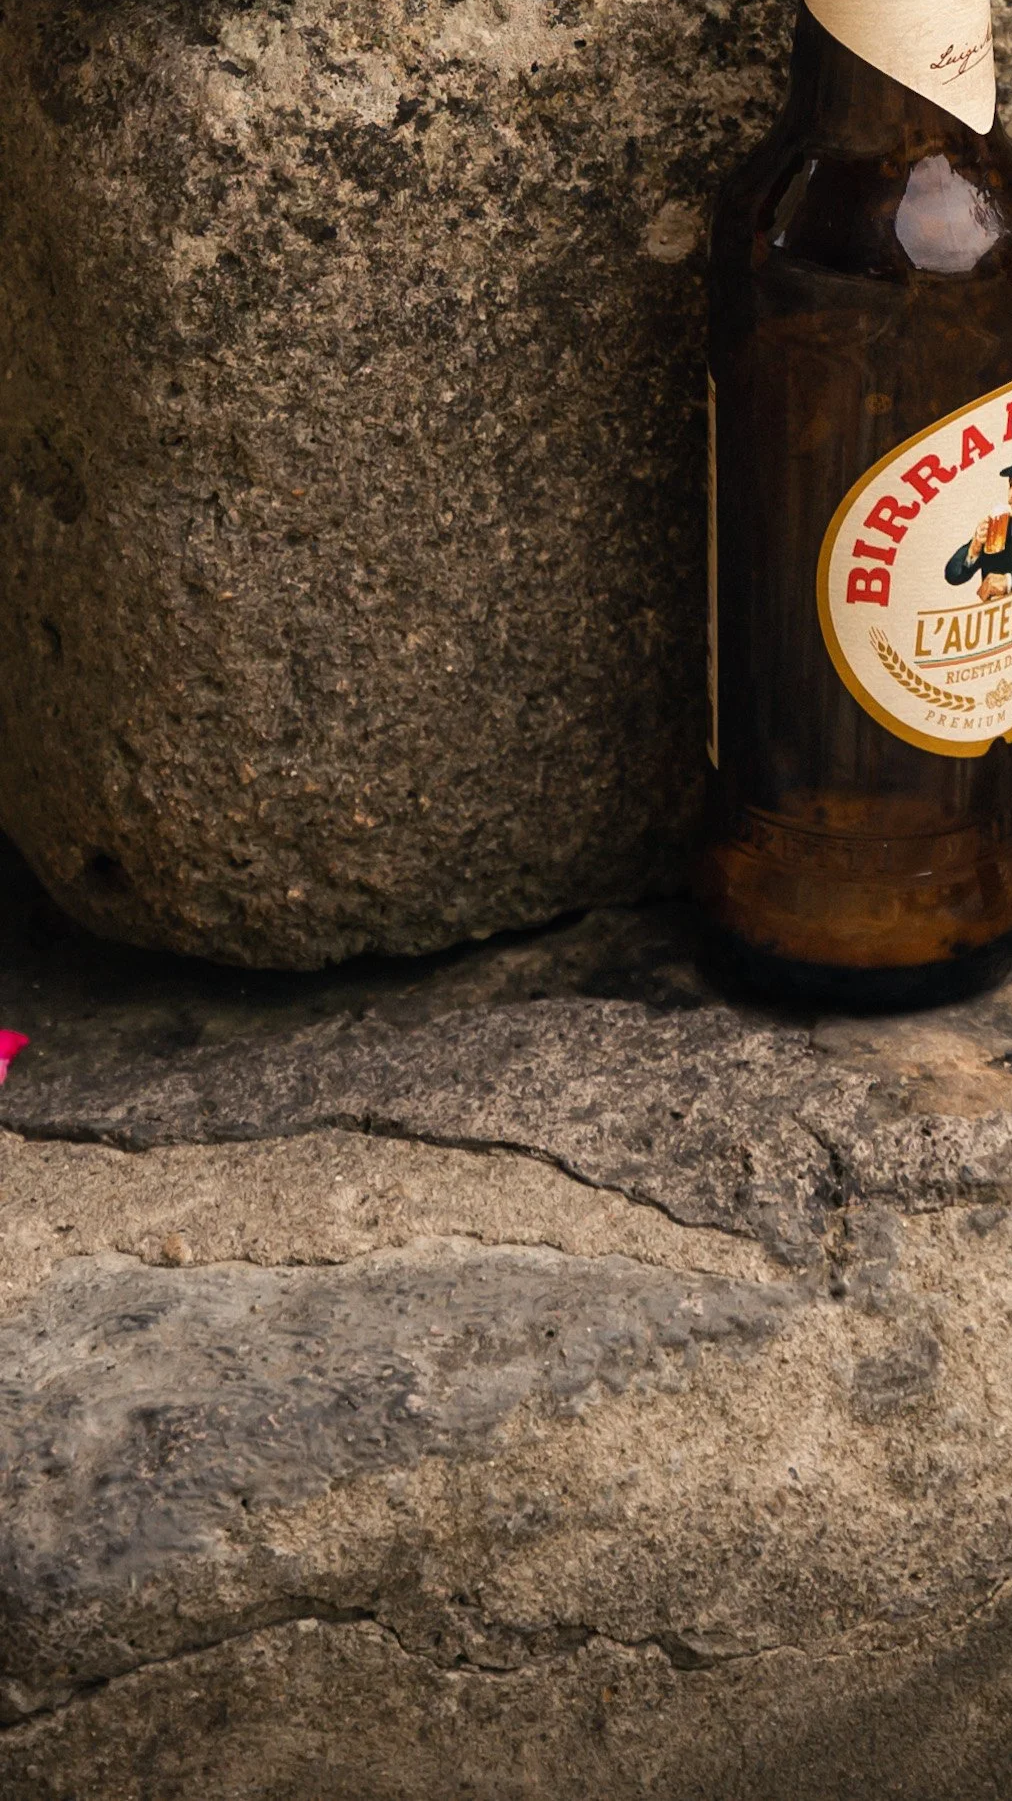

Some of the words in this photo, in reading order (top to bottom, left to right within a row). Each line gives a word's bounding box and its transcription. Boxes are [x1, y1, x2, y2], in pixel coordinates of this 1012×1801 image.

[930, 44, 977, 75] Luigi
[846, 424, 995, 607] BIRRA
[946, 659, 1002, 685] RICETTA
[924, 709, 1006, 730] PREMIUM
